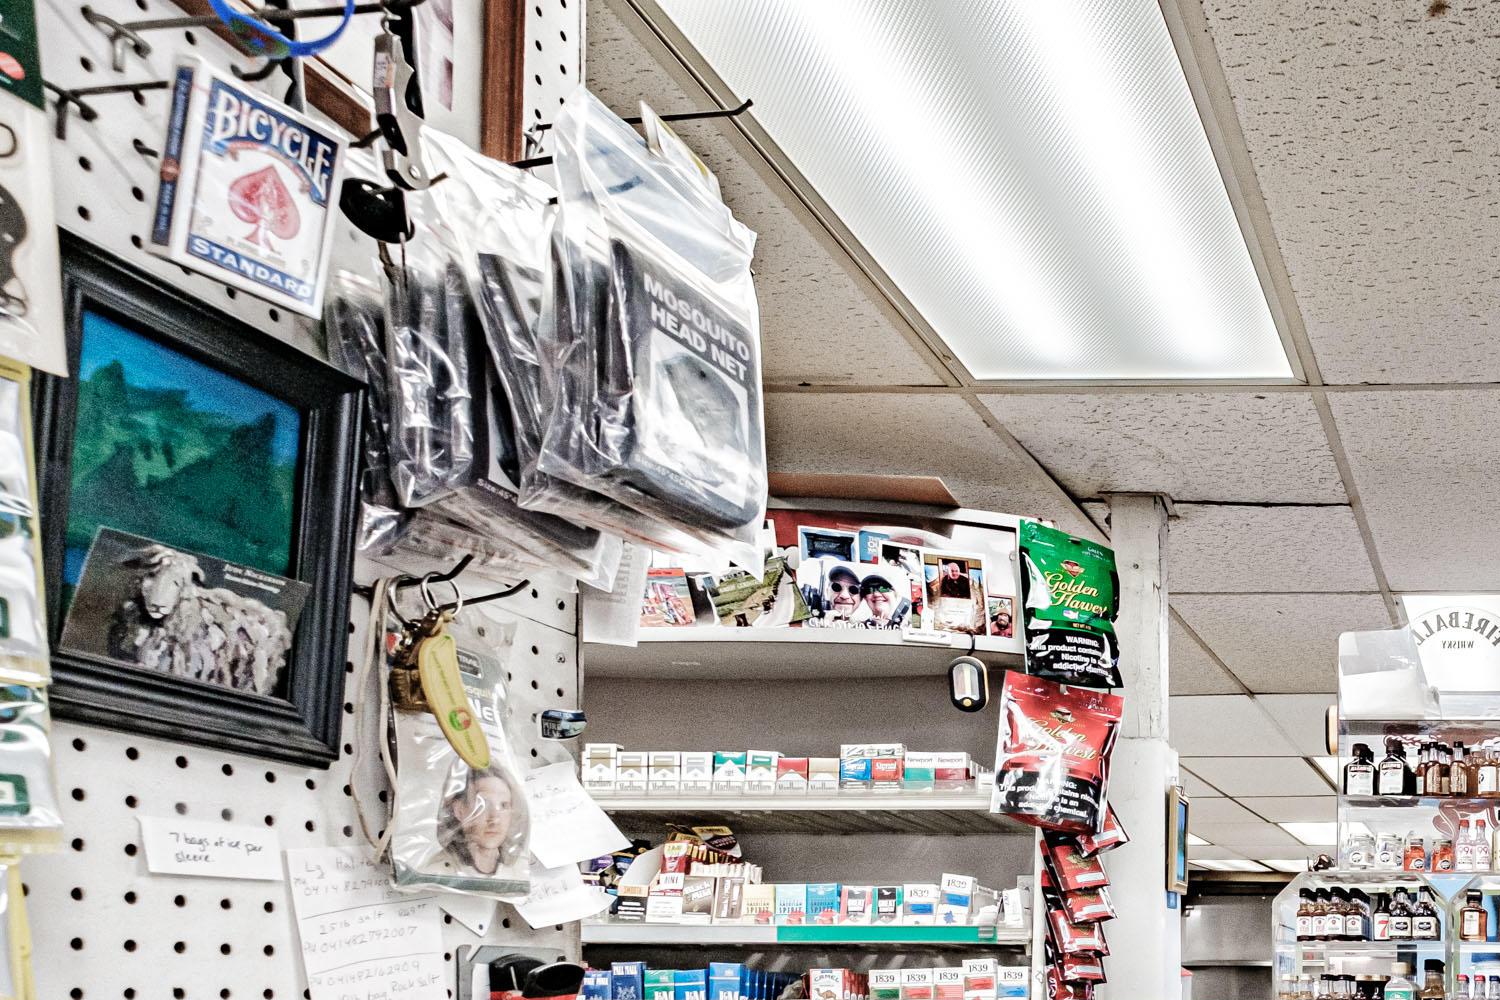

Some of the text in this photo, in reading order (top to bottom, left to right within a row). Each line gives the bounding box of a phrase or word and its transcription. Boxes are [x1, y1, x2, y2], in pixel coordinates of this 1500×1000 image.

[212, 88, 332, 200] BICYCLE
[190, 237, 312, 300] STANDARD
[643, 272, 750, 361] MOSQUITO
[650, 301, 748, 381] HEAD NET
[1044, 570, 1099, 597] Golden
[1048, 644, 1076, 653] product
[1061, 653, 1090, 664] Nicotine
[168, 832, 180, 843] 7
[184, 833, 209, 851] bags
[245, 843, 263, 856] per
[968, 964, 988, 973] 1839
[814, 974, 840, 983] CAMEL
[875, 974, 895, 983] 1839
[906, 974, 927, 983] 1839
[939, 972, 959, 981] 1839
[1003, 971, 1023, 980] 1839
